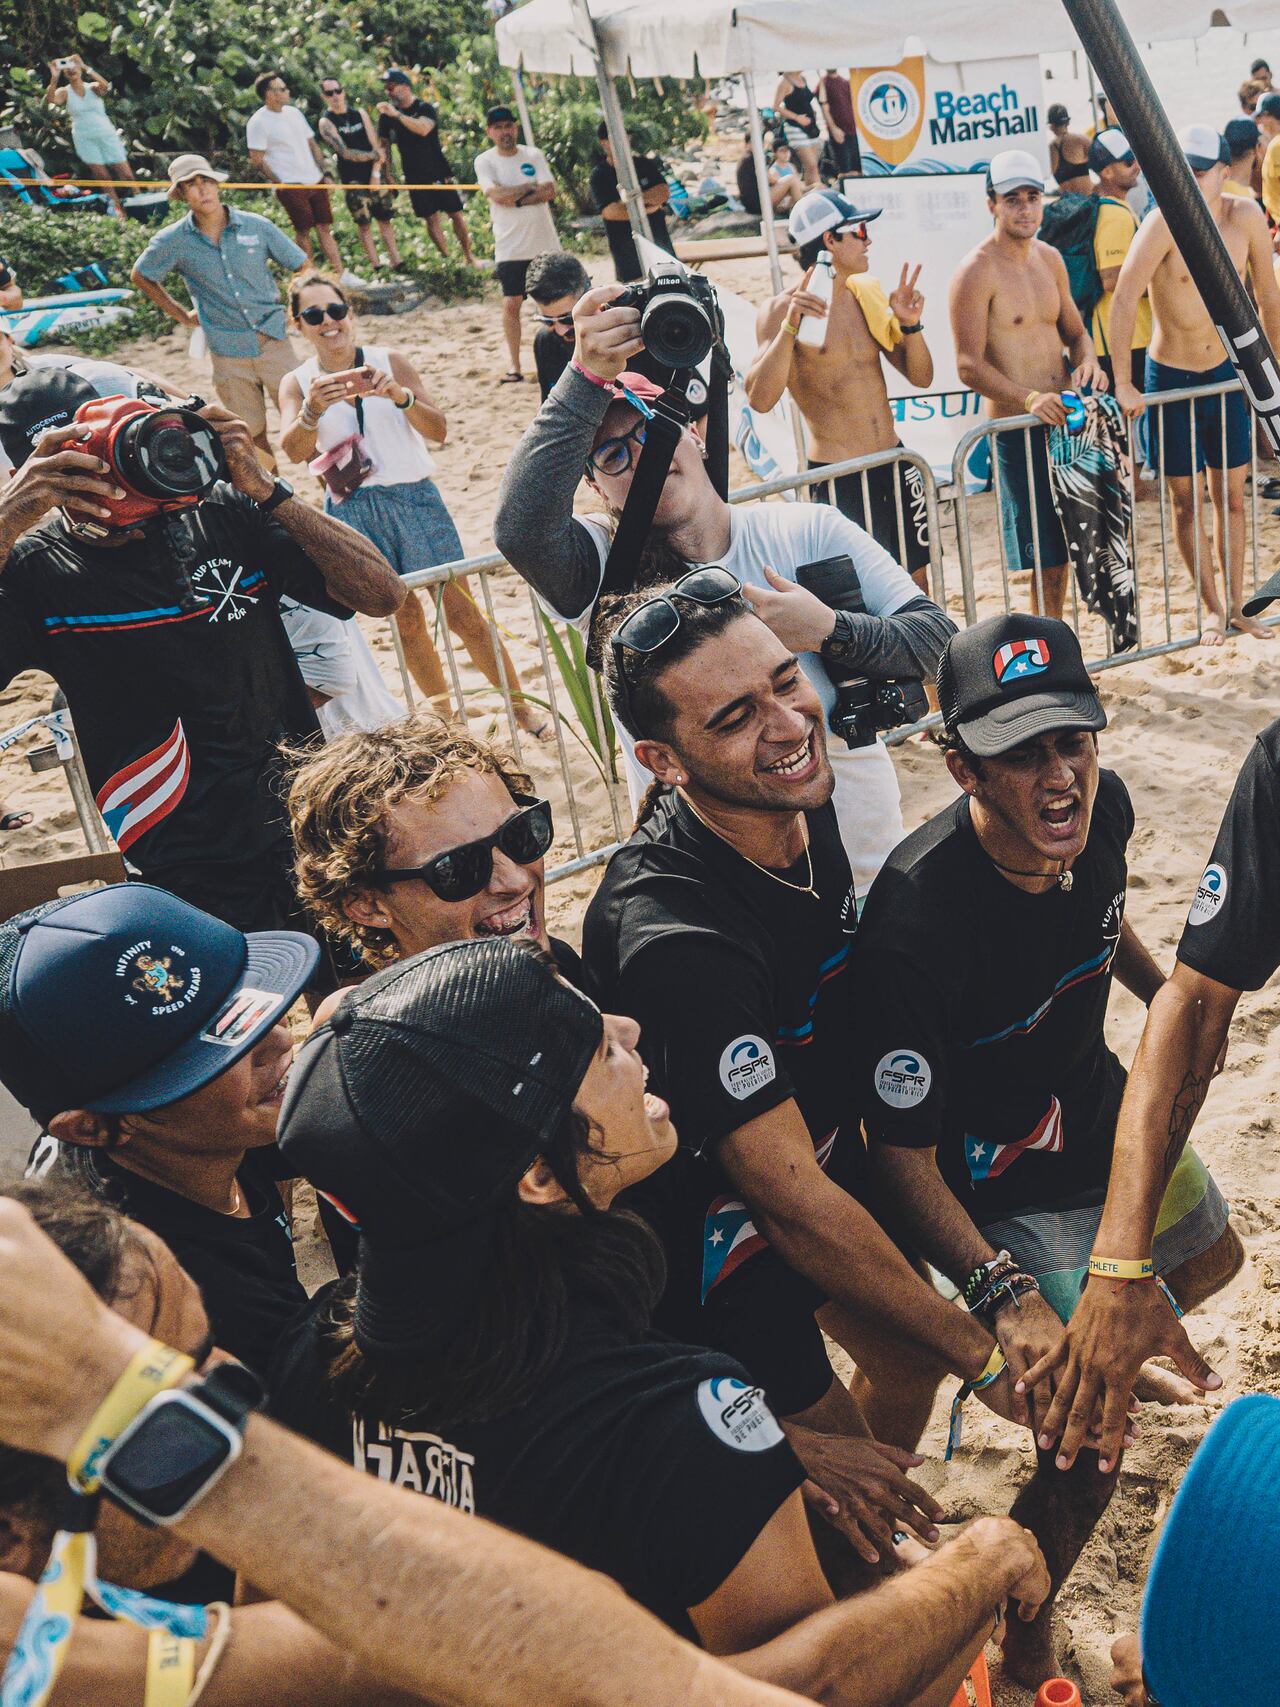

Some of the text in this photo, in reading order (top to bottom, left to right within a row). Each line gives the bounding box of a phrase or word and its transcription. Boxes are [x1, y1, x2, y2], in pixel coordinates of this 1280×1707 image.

[935, 84, 1018, 119] Beach
[929, 106, 1038, 145] Marshall
[658, 278, 680, 286] Nikon
[26, 411, 68, 437] AUTOCENTRO
[191, 558, 232, 582] SUP TEAM
[228, 607, 247, 621] PUR
[840, 895, 850, 920] SUP
[1102, 905, 1113, 928] SUP
[115, 940, 152, 977] INFINITY
[152, 966, 202, 1016] SPEED FREAKS
[727, 1055, 770, 1082] FSPR
[881, 1070, 926, 1086] FSPR
